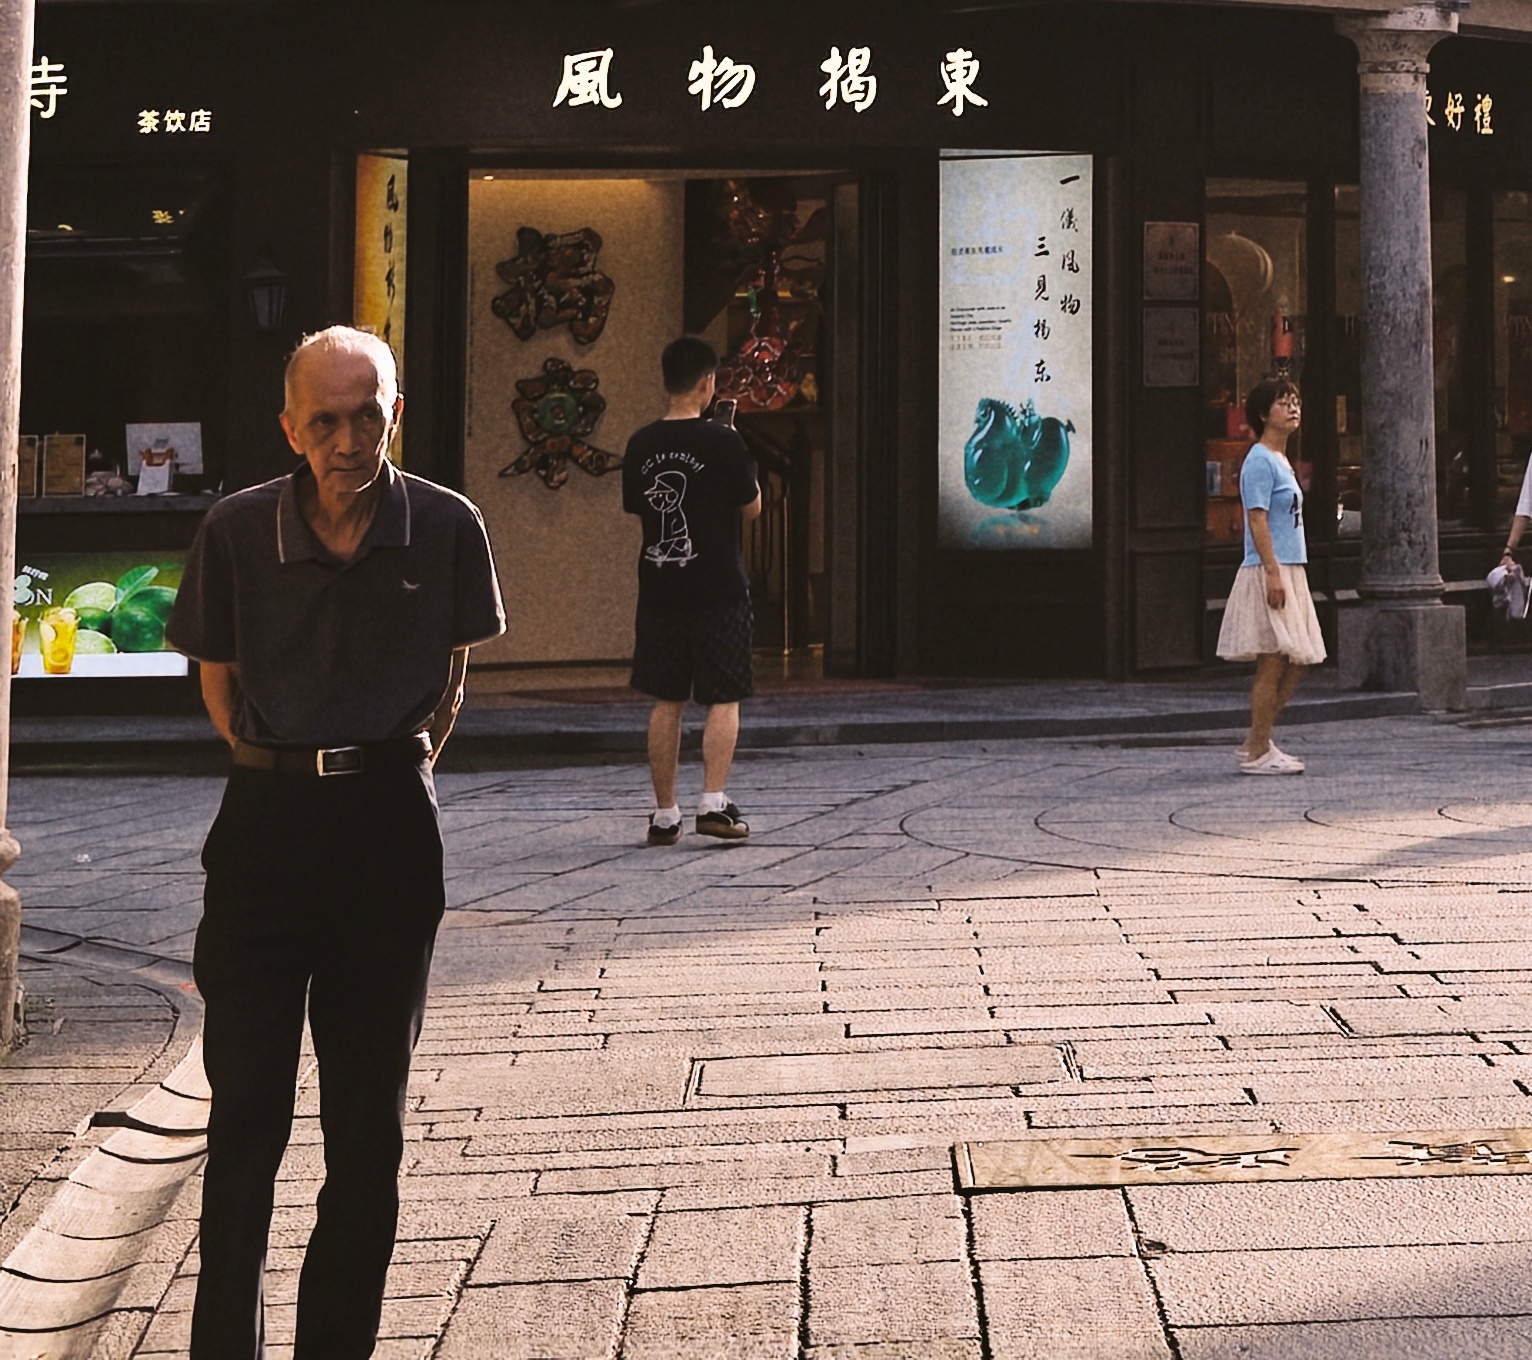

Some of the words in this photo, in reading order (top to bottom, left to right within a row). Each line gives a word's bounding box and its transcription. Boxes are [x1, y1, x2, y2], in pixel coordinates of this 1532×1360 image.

[552, 45, 989, 117] 風物揭東
[136, 108, 213, 135] 茶饮店
